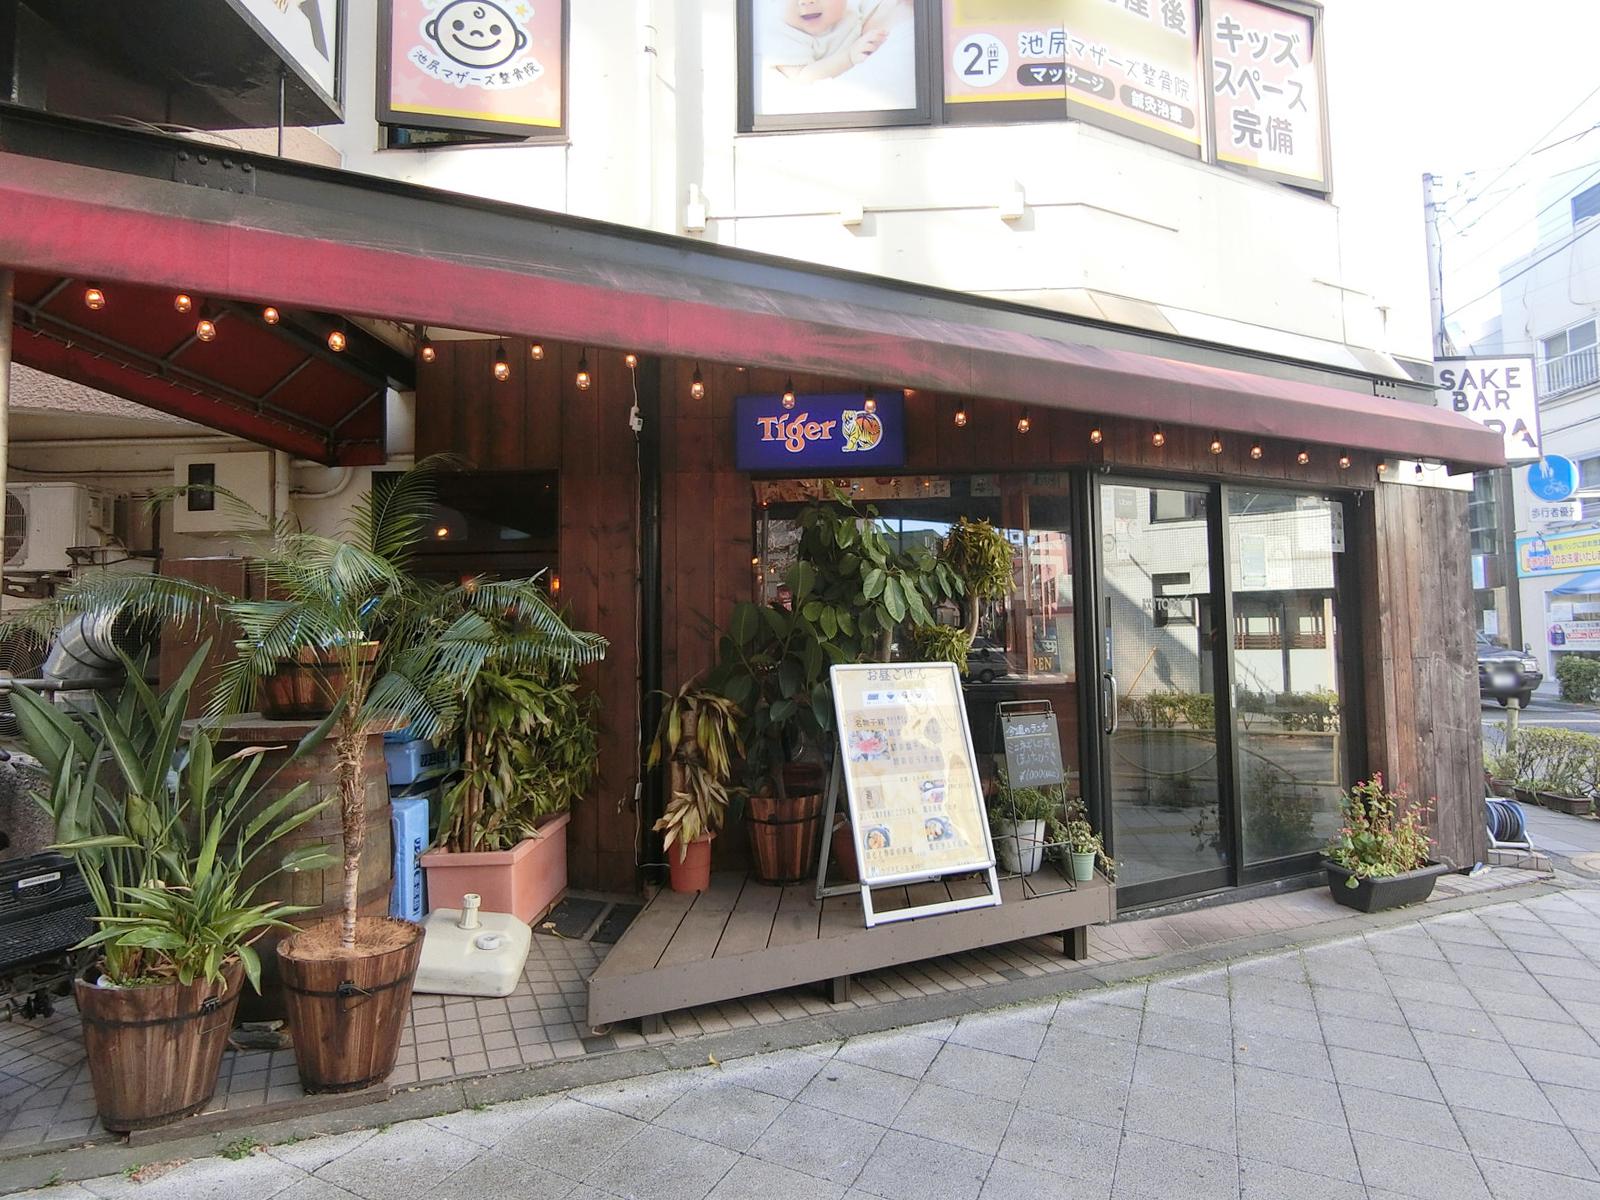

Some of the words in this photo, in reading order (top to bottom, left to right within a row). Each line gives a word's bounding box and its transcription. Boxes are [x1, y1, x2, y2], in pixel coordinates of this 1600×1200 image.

[1216, 16, 1300, 68] キッズ
[413, 50, 540, 86] 池尻マザーズ整骨院
[1020, 31, 1190, 102] 池尻マザーズ整骨院
[1029, 66, 1105, 92] マッサージ
[1214, 60, 1307, 112] スペース
[1131, 92, 1183, 123] 鍼灸治療
[1232, 109, 1294, 155] 完備
[1439, 367, 1521, 391] SAKE
[1452, 390, 1510, 412] BAR
[757, 413, 837, 453] Tiger
